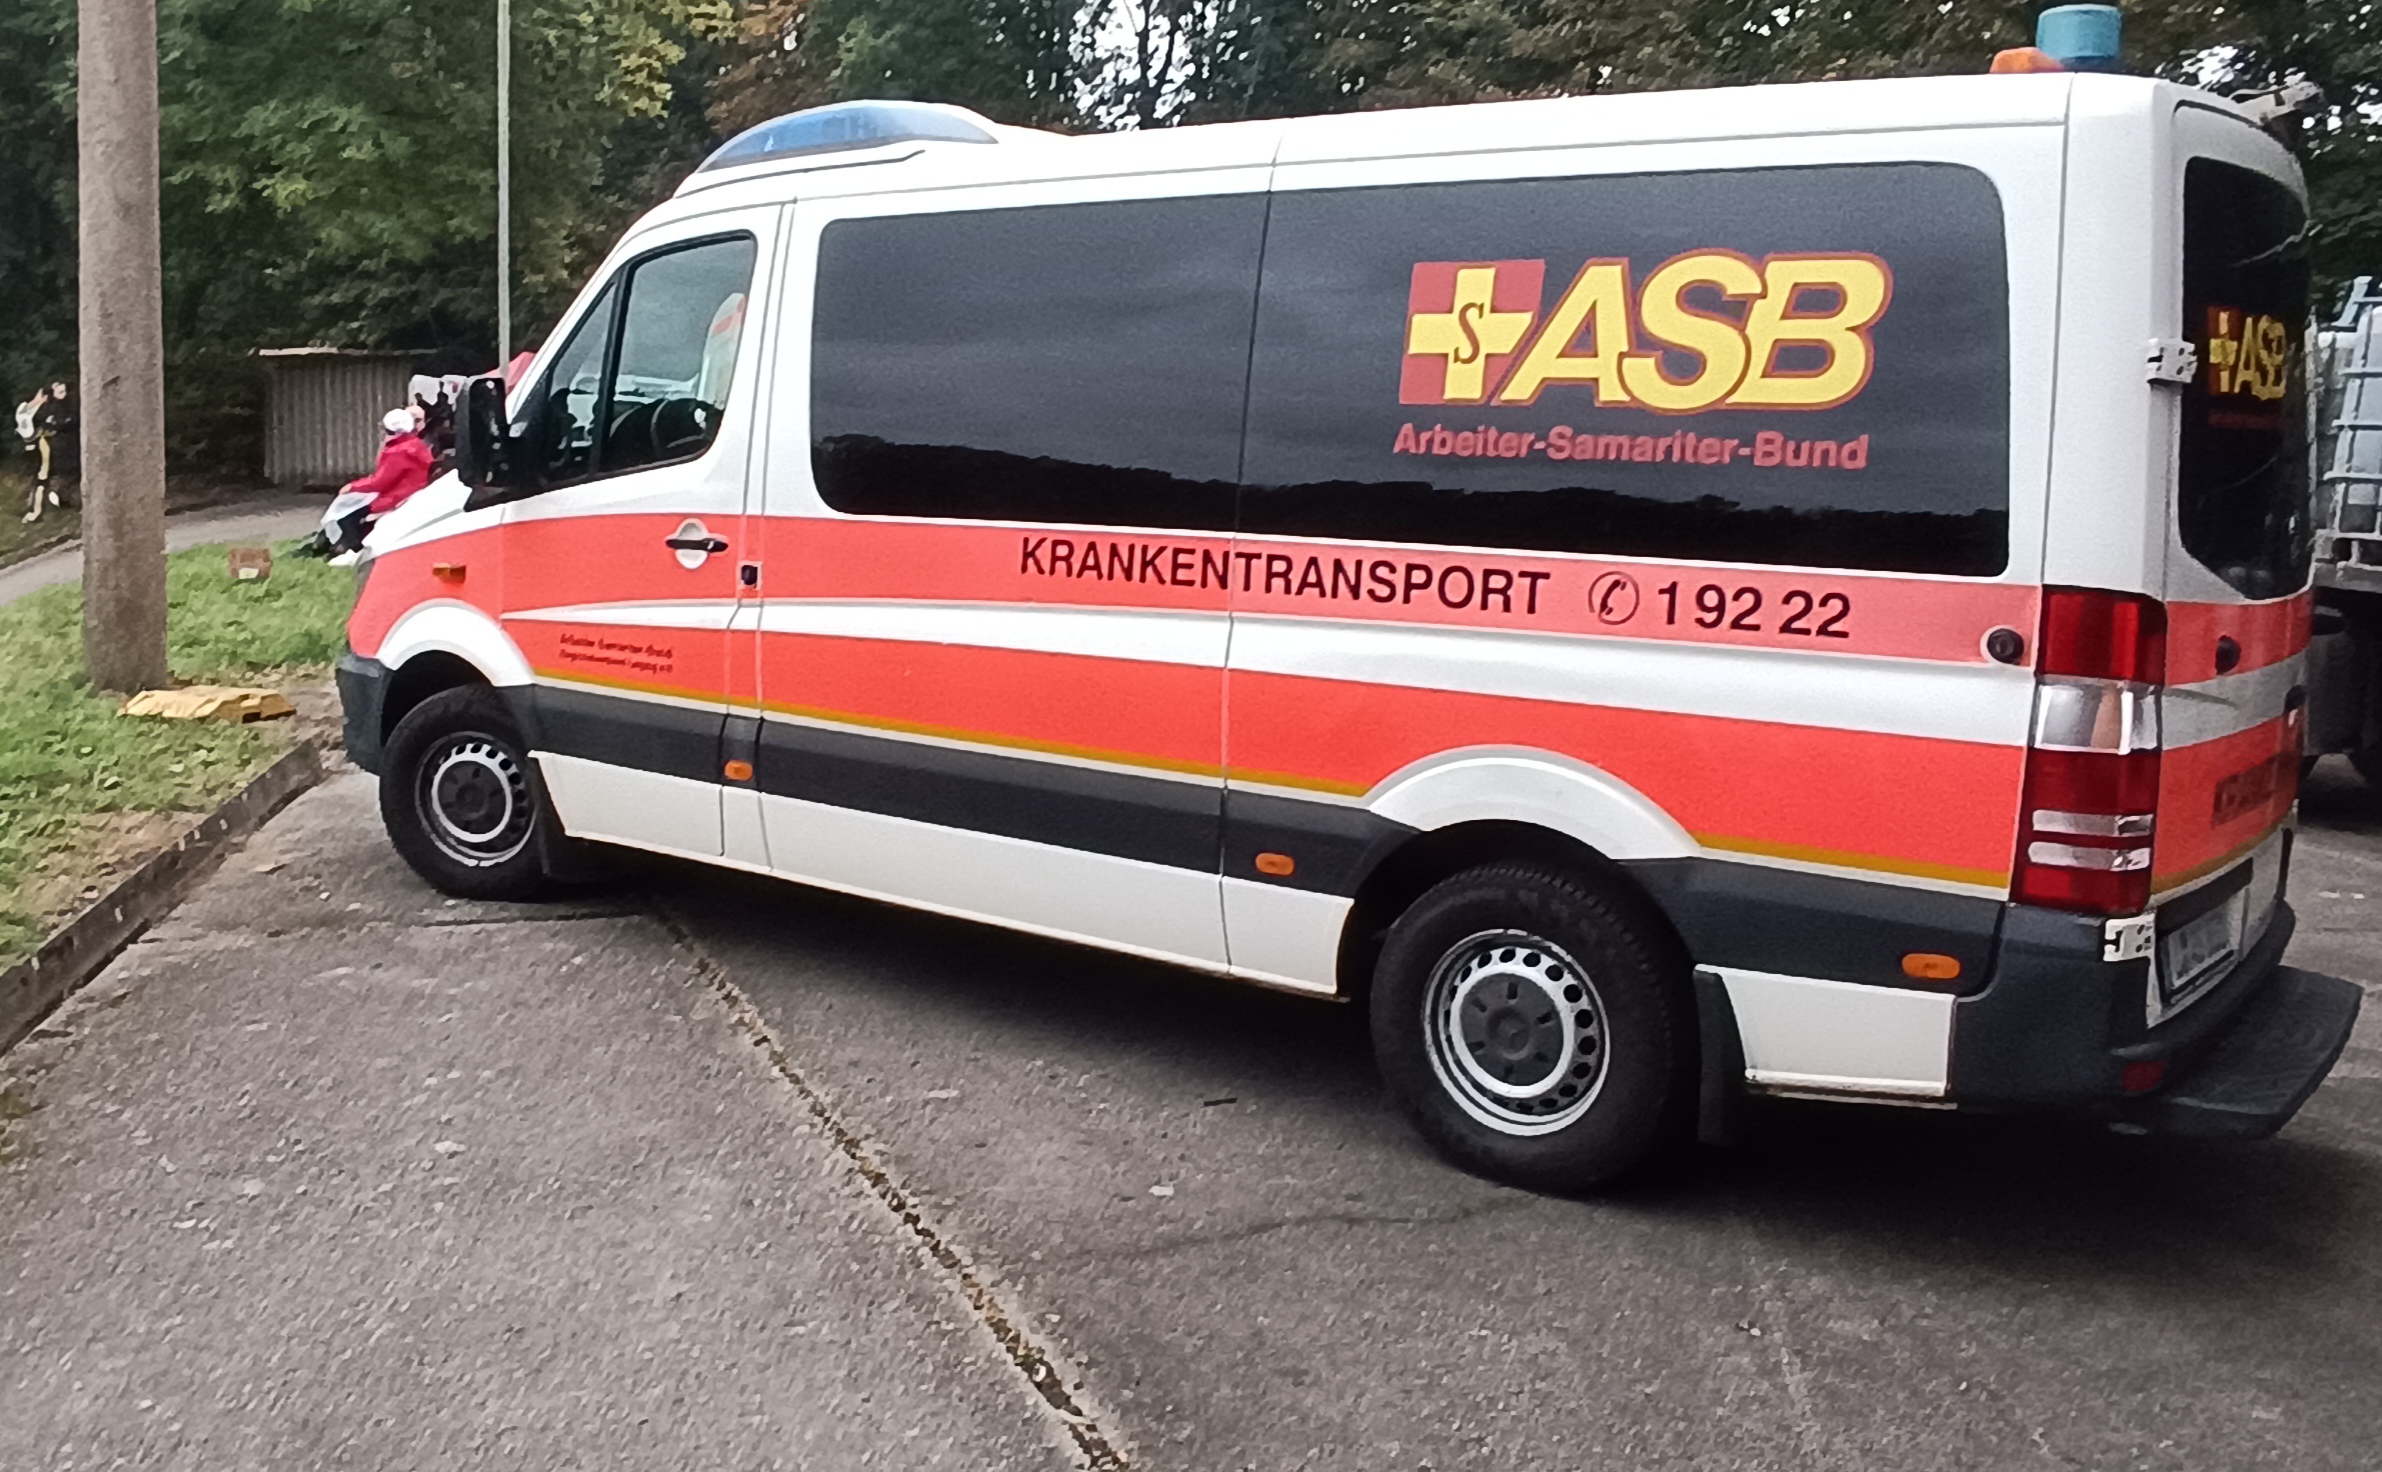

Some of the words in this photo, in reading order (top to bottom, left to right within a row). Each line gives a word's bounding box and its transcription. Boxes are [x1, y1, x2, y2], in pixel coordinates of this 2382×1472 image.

[1490, 248, 1894, 415] ASB
[1393, 422, 1870, 470] Arbeiter-Samariter-Bund
[1019, 536, 1551, 615] KRANKENTRANSPORT
[1778, 589, 1851, 639] 22
